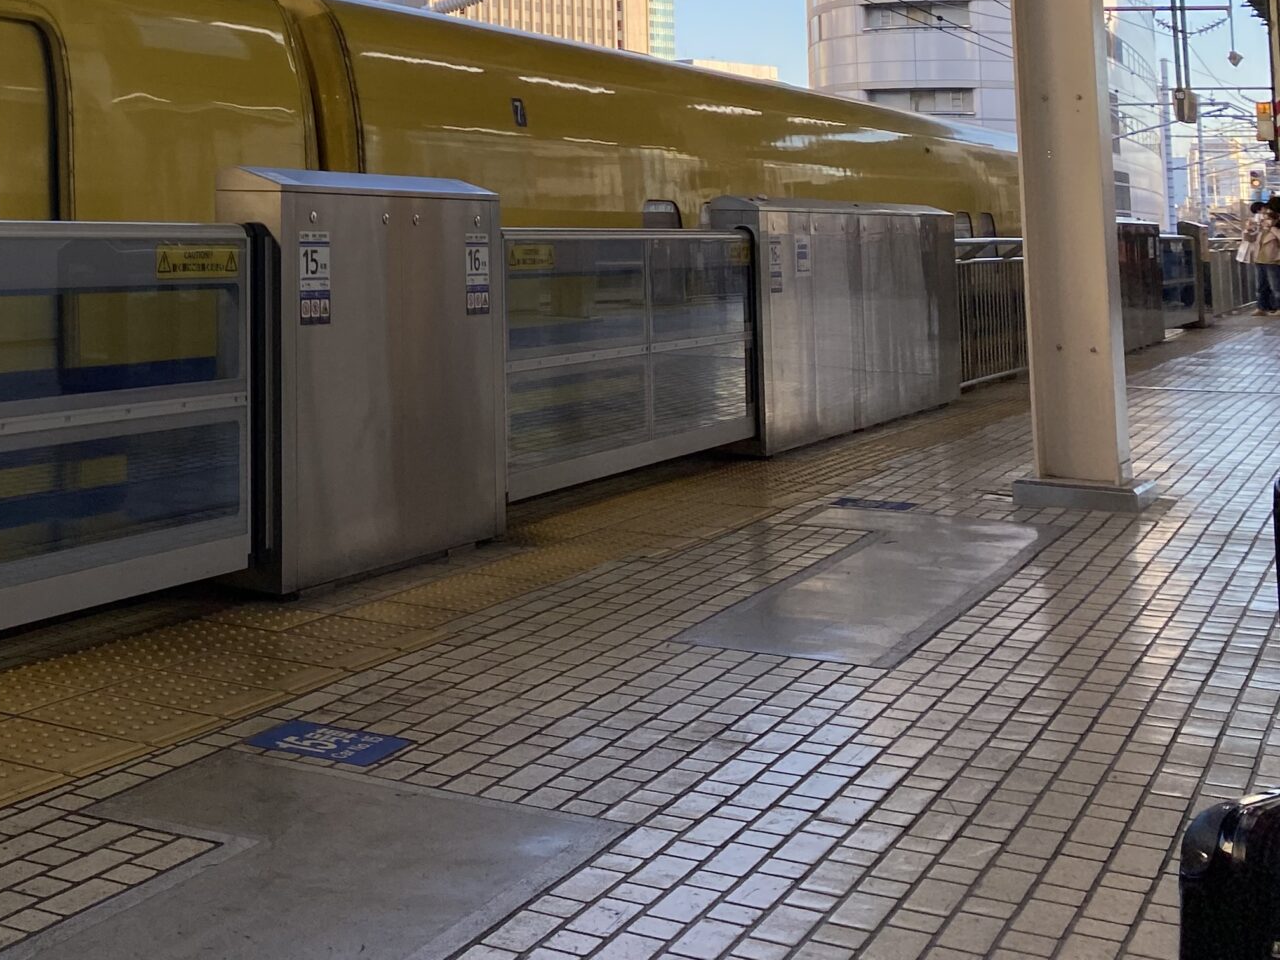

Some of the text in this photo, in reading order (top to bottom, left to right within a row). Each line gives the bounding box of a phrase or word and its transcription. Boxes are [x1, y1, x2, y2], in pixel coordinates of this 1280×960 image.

[513, 101, 522, 123] 7
[303, 249, 319, 275] 15
[468, 249, 481, 271] 16
